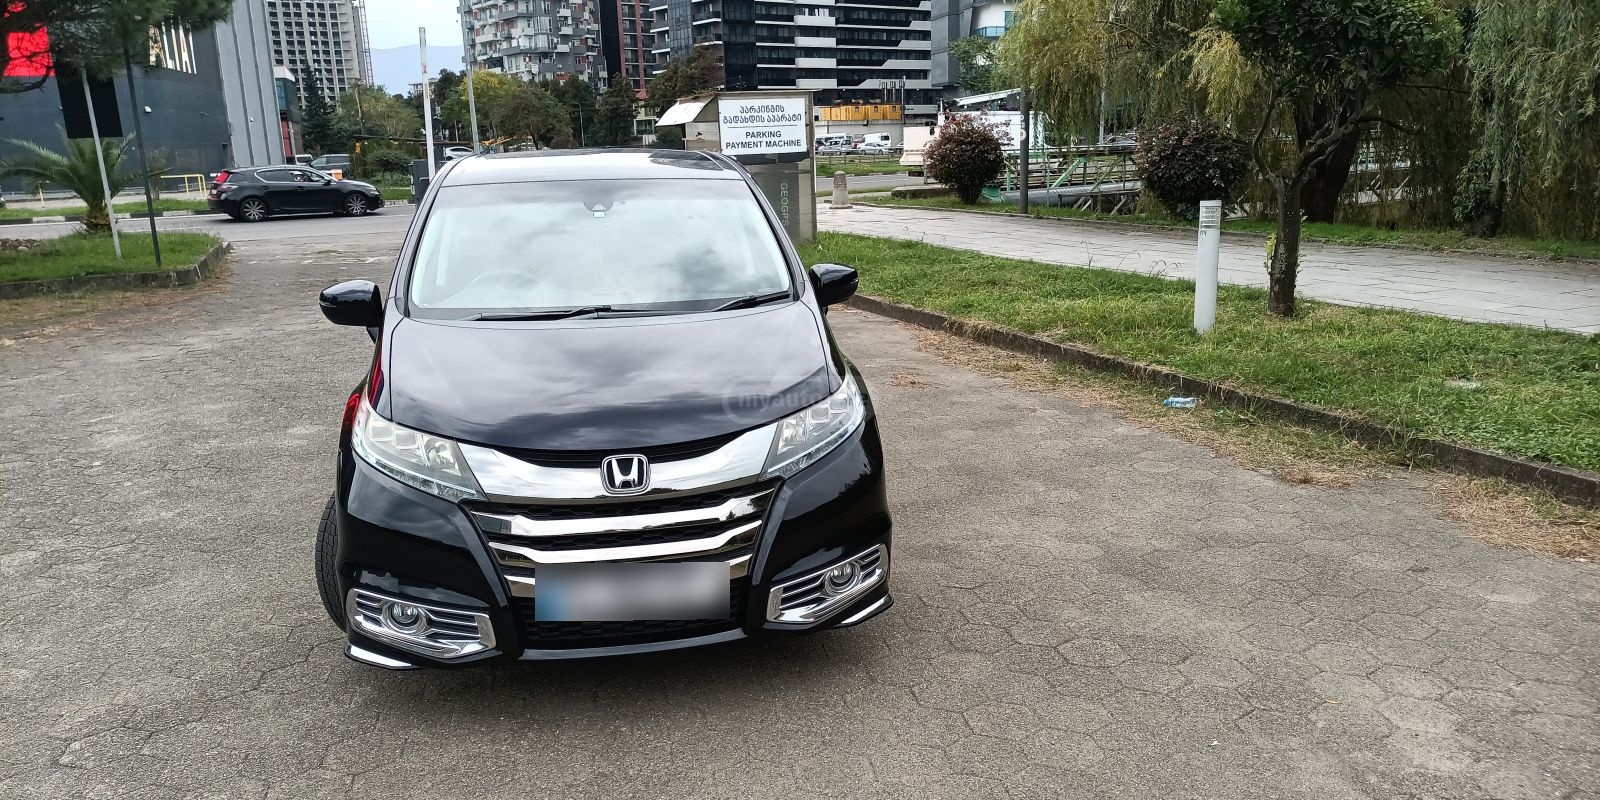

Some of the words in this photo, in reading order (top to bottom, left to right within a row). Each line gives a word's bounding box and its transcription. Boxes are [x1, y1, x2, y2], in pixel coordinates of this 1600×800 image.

[739, 104, 785, 114] პარკინგის
[722, 115, 766, 124] გადახდის
[766, 113, 802, 123] აპარატი
[745, 130, 782, 139] PARKING
[725, 141, 763, 149] PAYMENT
[765, 139, 802, 148] MACHINE
